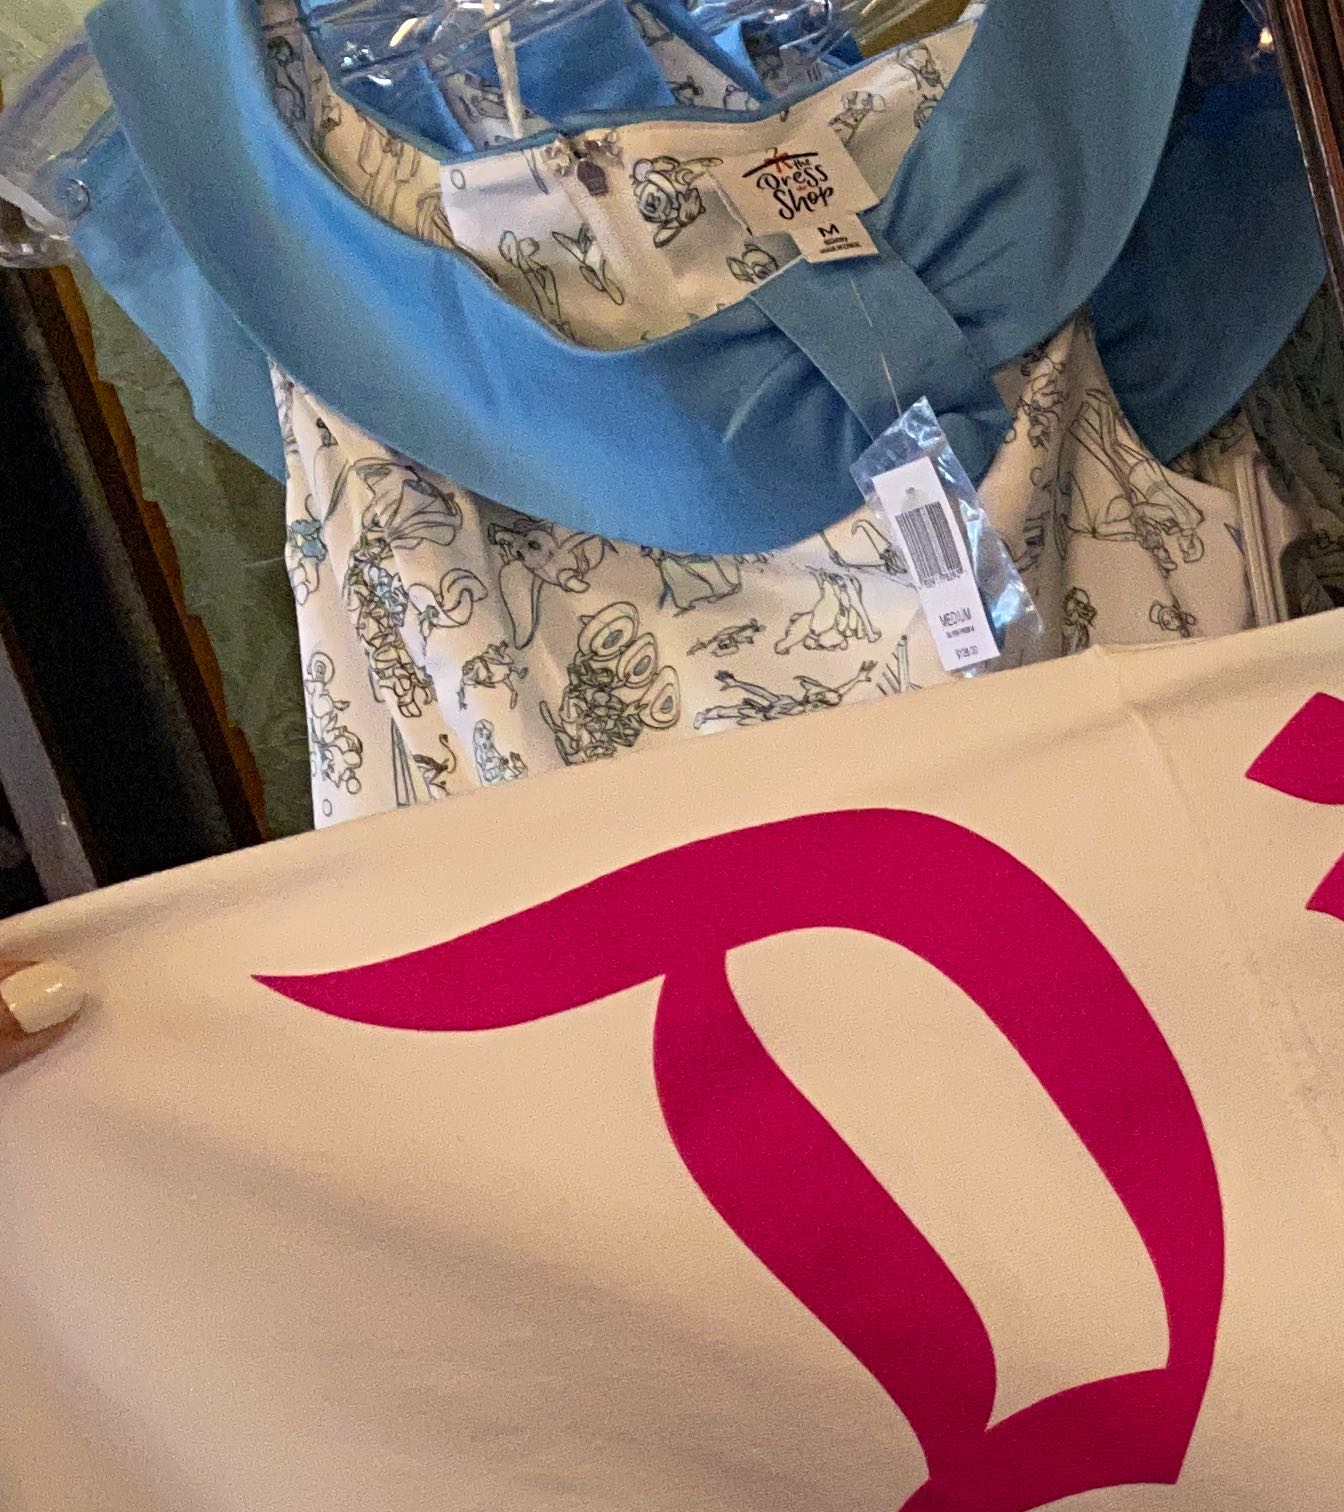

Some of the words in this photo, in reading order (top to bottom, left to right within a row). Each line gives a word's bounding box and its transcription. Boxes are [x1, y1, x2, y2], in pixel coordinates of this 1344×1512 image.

[792, 158, 812, 170] the
[756, 164, 829, 191] Dress
[772, 185, 834, 221] Shop
[816, 222, 840, 238] M
